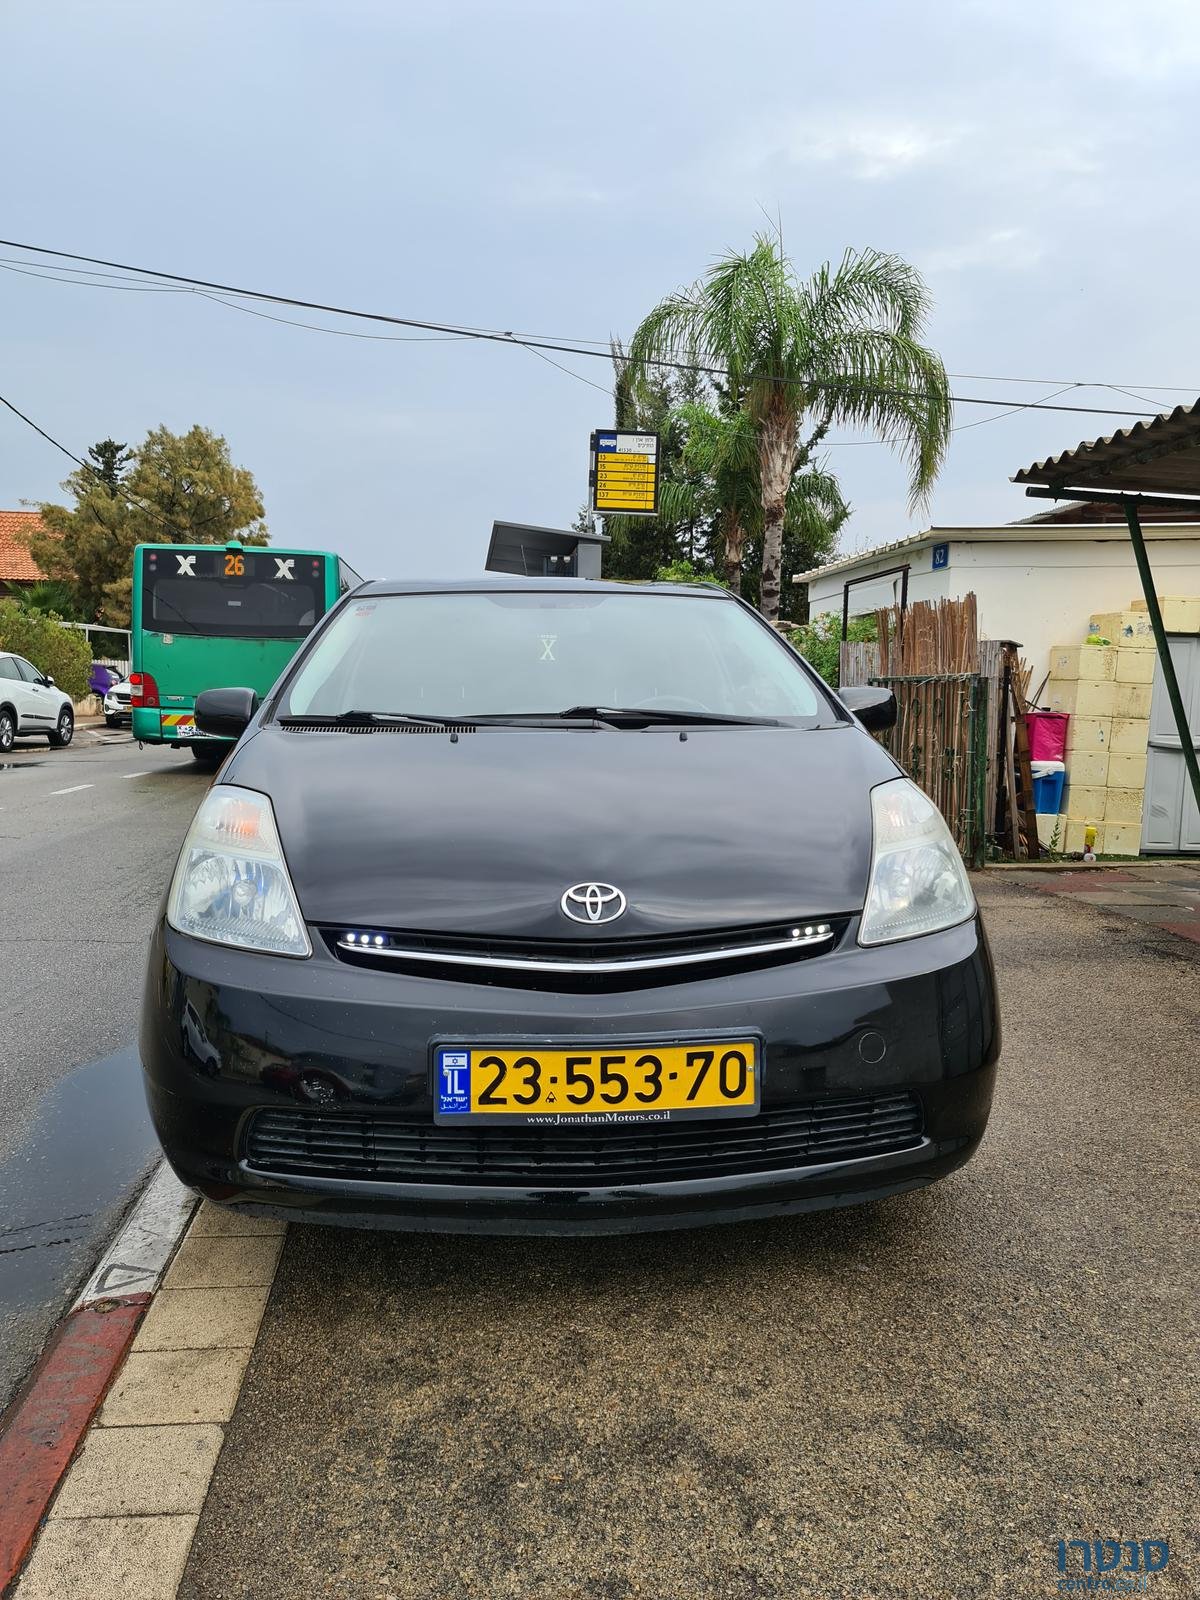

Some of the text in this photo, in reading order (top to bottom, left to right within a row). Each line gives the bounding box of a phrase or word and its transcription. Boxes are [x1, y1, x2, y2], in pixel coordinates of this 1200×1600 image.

[224, 554, 245, 576] 26
[935, 549, 944, 564] 82
[446, 1070, 465, 1094] IL
[527, 1110, 671, 1126] www.JonathanMotors.co.il
